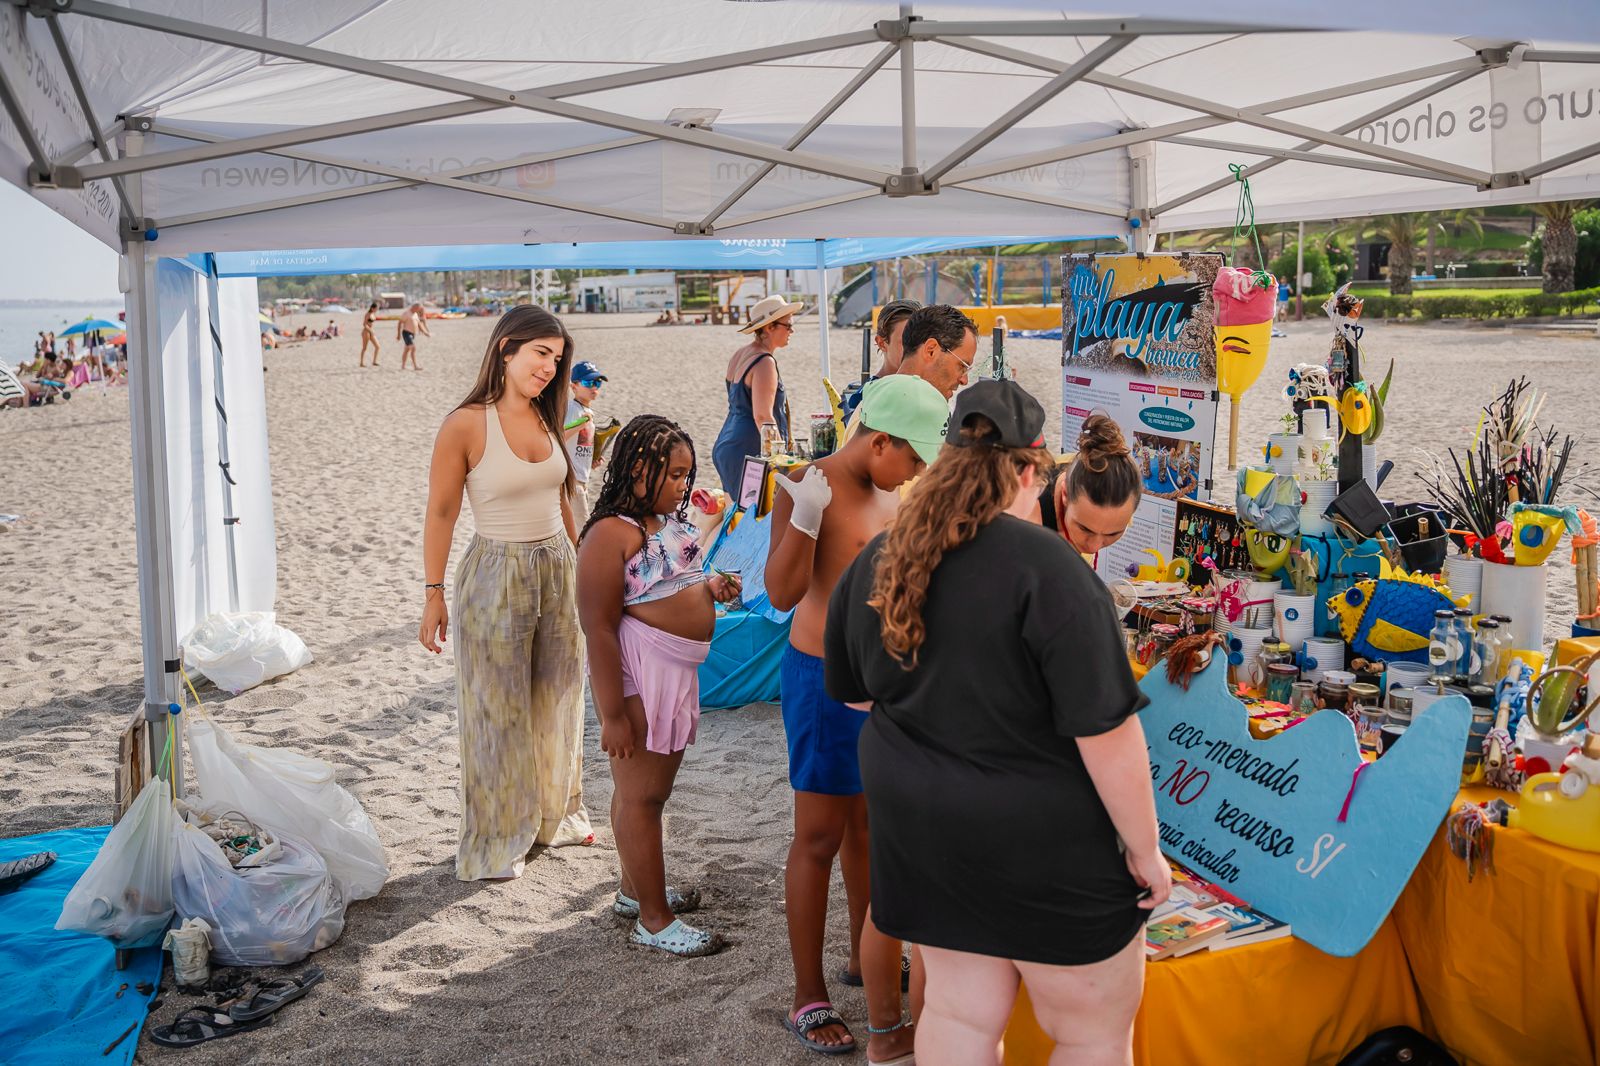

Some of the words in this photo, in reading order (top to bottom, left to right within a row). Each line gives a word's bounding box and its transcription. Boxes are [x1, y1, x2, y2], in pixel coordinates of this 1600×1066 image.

[1073, 263, 1099, 296] mi
[1072, 268, 1188, 359] playa
[1144, 341, 1201, 369] bonica
[1168, 721, 1299, 797] eco-mercado
[1159, 759, 1210, 806] NO
[1214, 798, 1294, 858] recurso
[1181, 837, 1241, 885] circular
